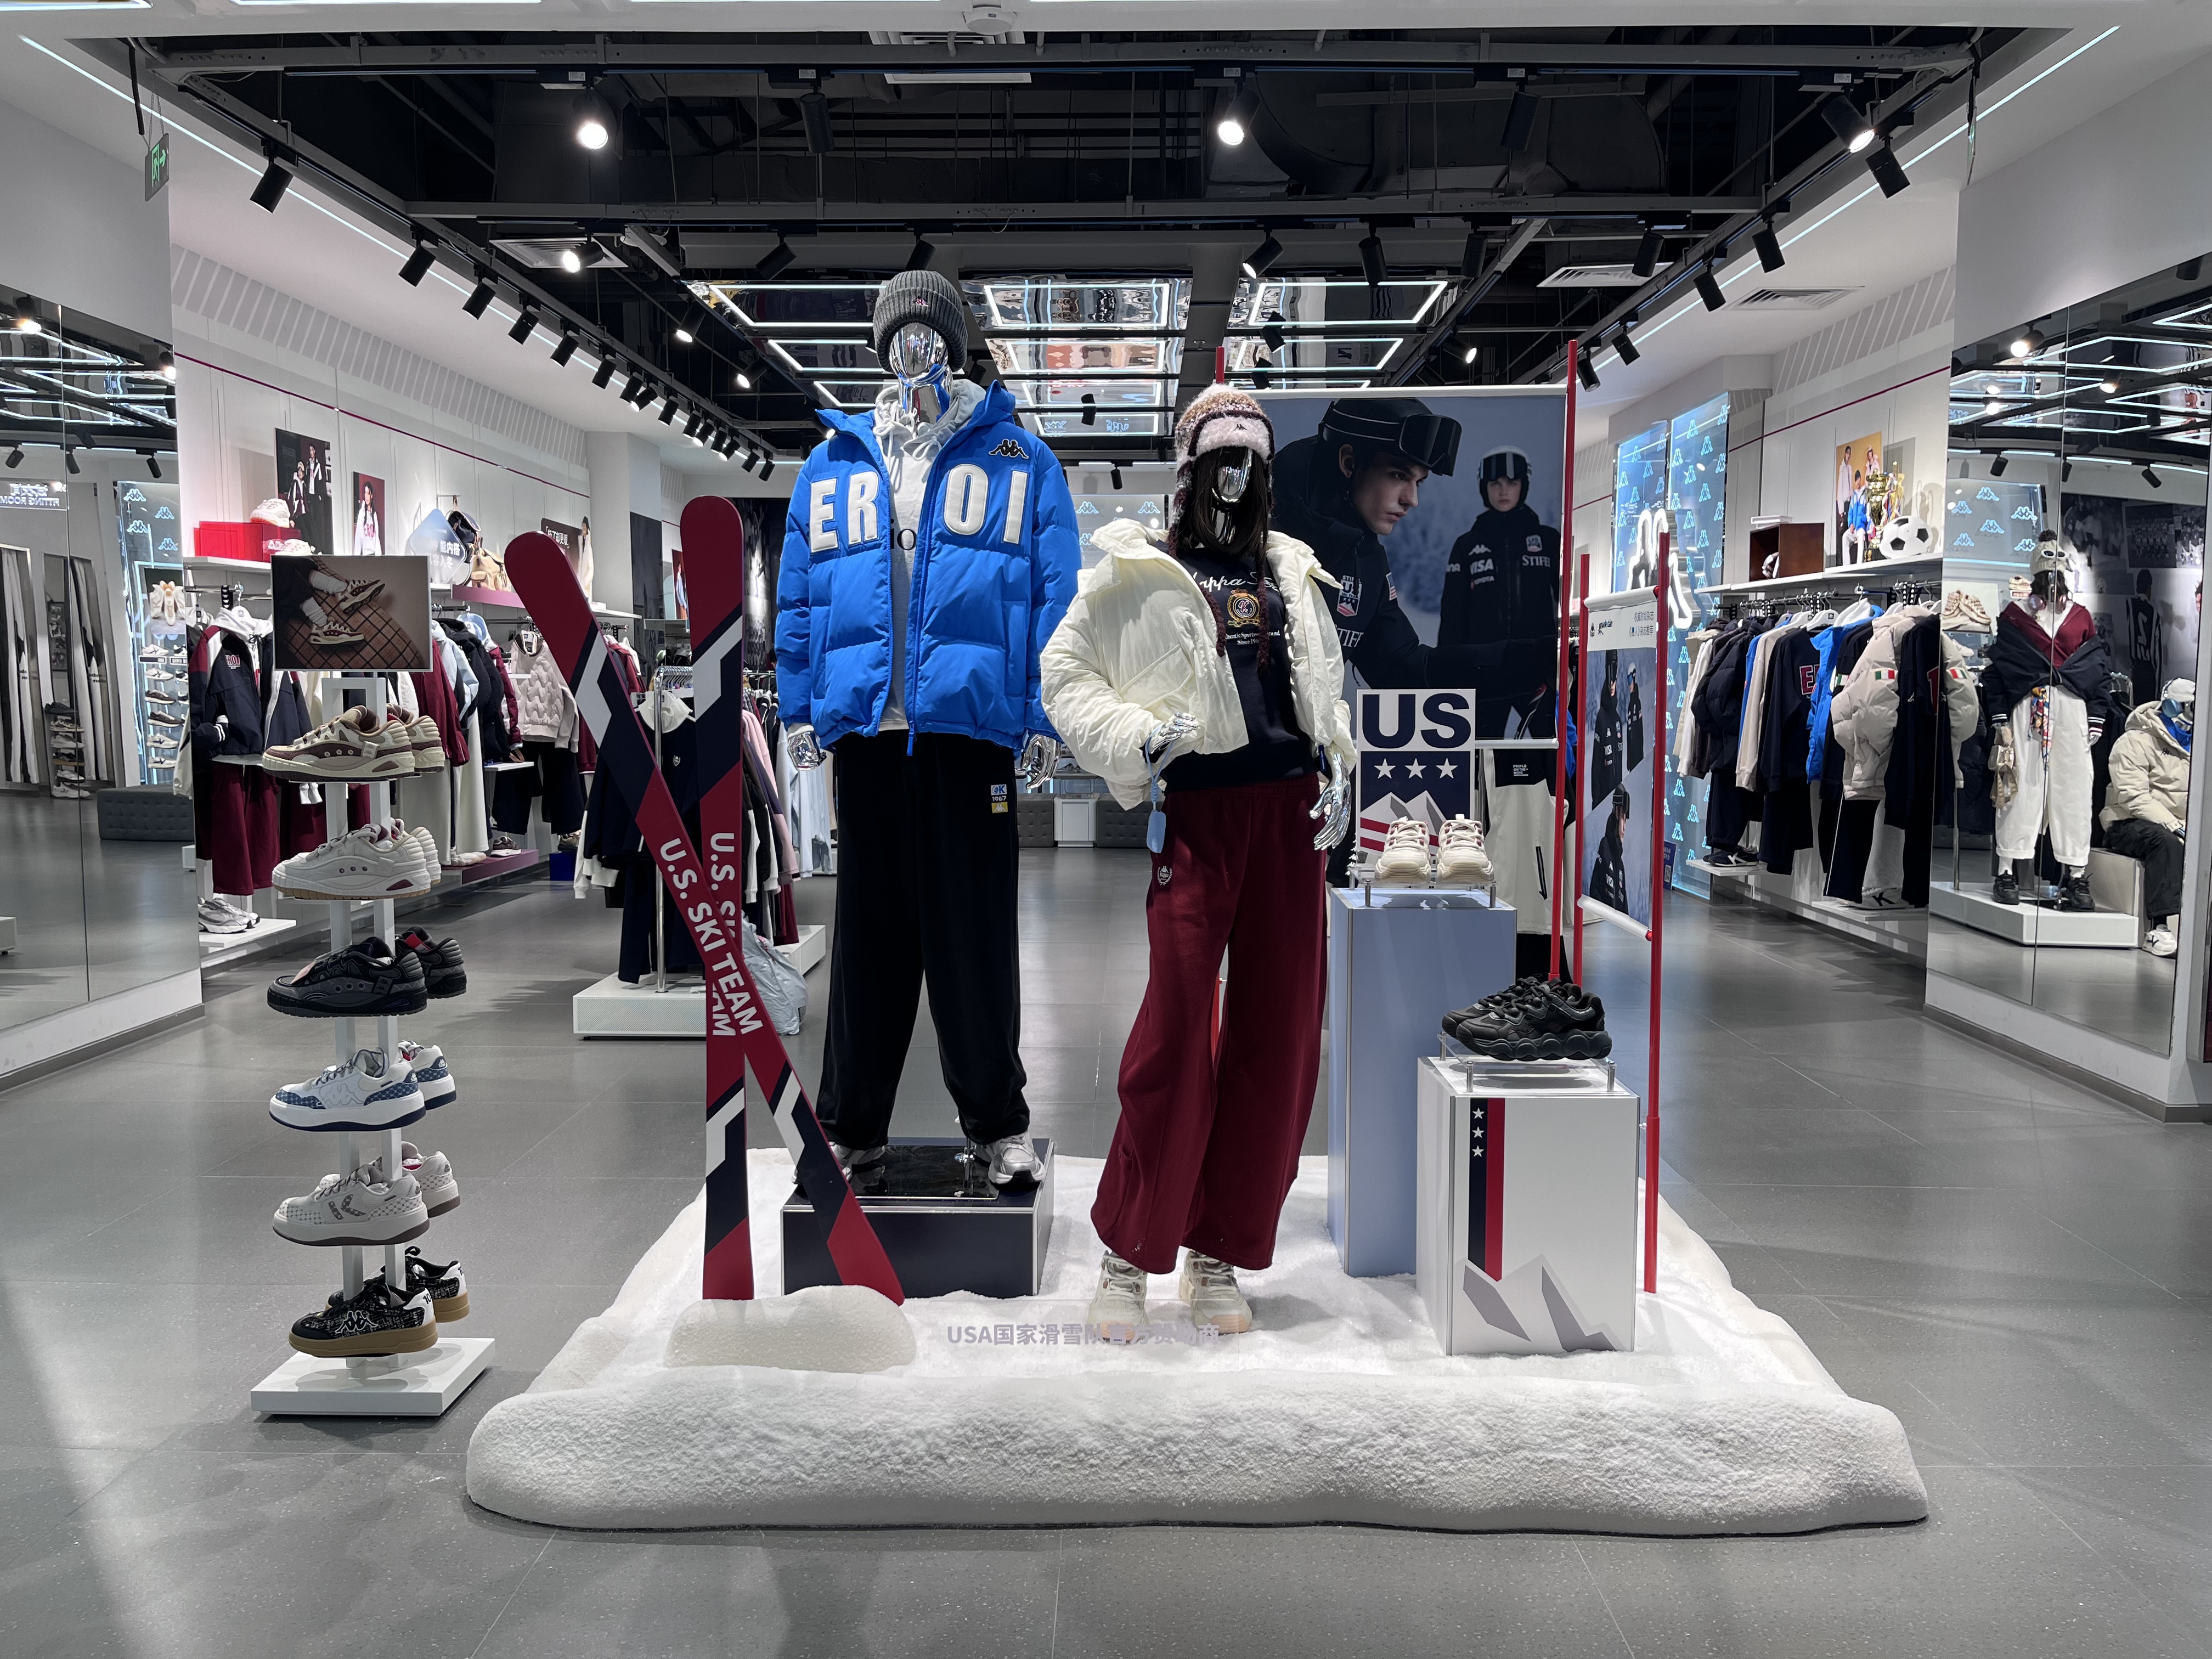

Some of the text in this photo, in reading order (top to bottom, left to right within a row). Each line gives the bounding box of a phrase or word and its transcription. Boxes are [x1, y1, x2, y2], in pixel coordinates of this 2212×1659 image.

[1470, 558, 1494, 575] VISA
[1193, 572, 1246, 592] appa
[225, 654, 241, 665] ROI
[1362, 692, 1471, 749] US
[710, 832, 736, 891] U.S.
[660, 838, 764, 1035] U.S. SKI TEAM
[422, 1293, 432, 1305] 10
